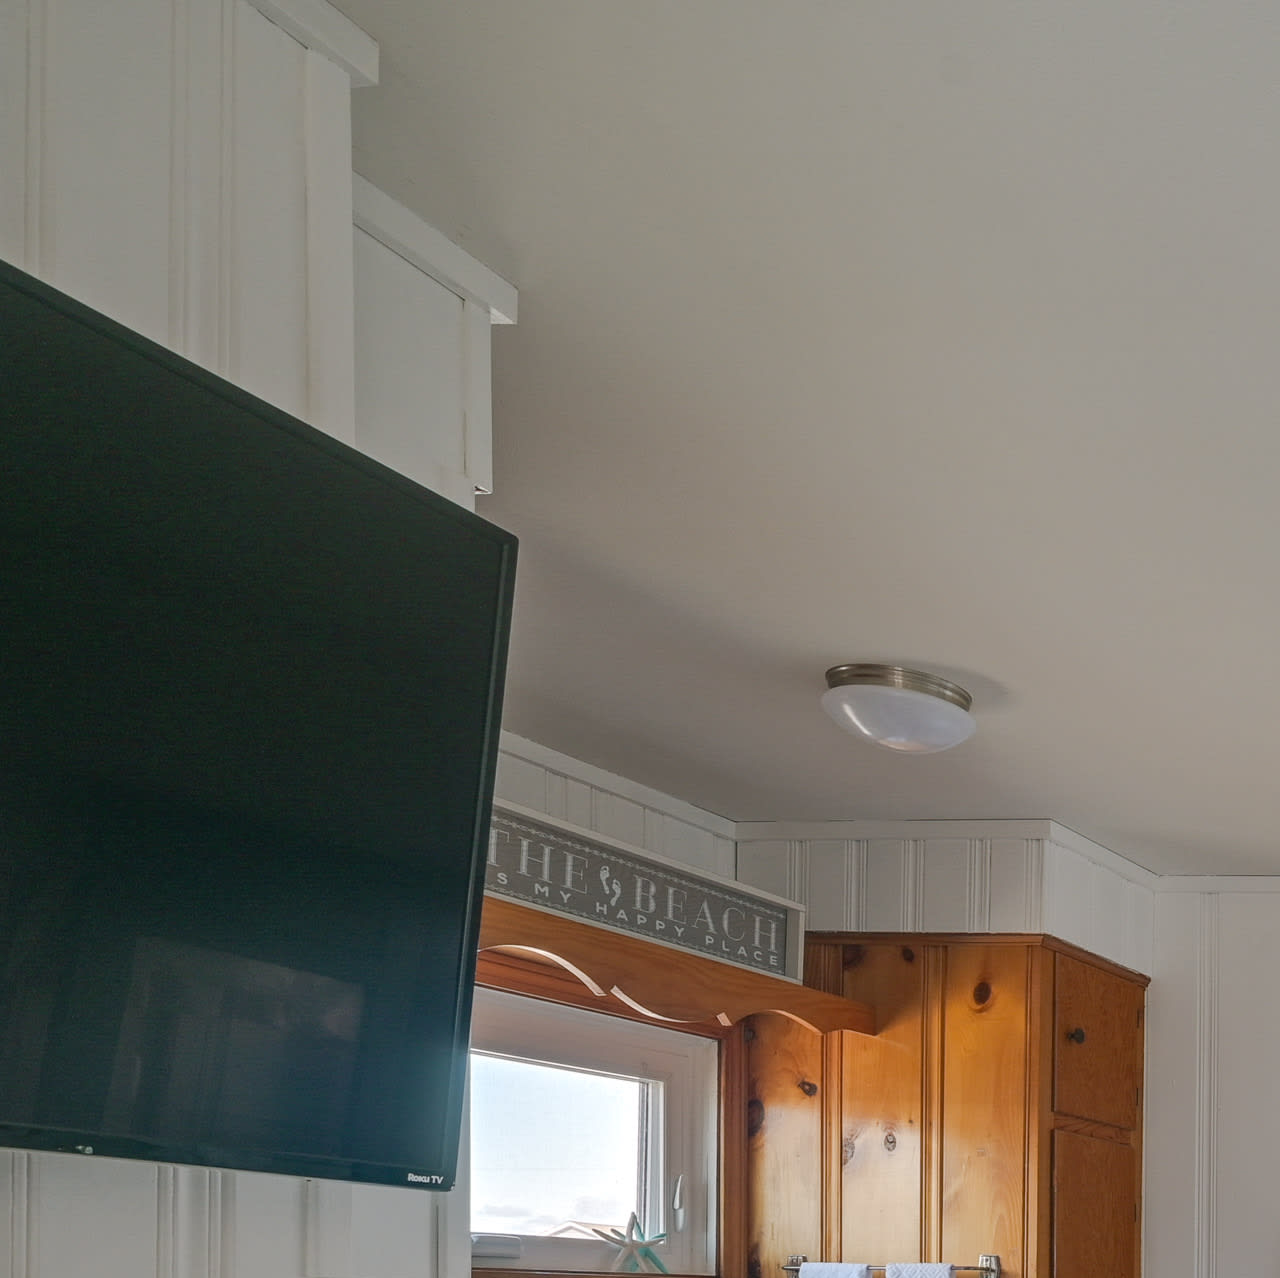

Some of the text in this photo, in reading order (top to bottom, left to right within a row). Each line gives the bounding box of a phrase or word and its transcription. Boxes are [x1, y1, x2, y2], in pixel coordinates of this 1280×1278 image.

[487, 828, 778, 953] THE BEACH
[534, 883, 572, 904] MY
[595, 902, 685, 937] HAPPY
[705, 935, 778, 966] PLACE
[431, 1175, 444, 1185] TV
